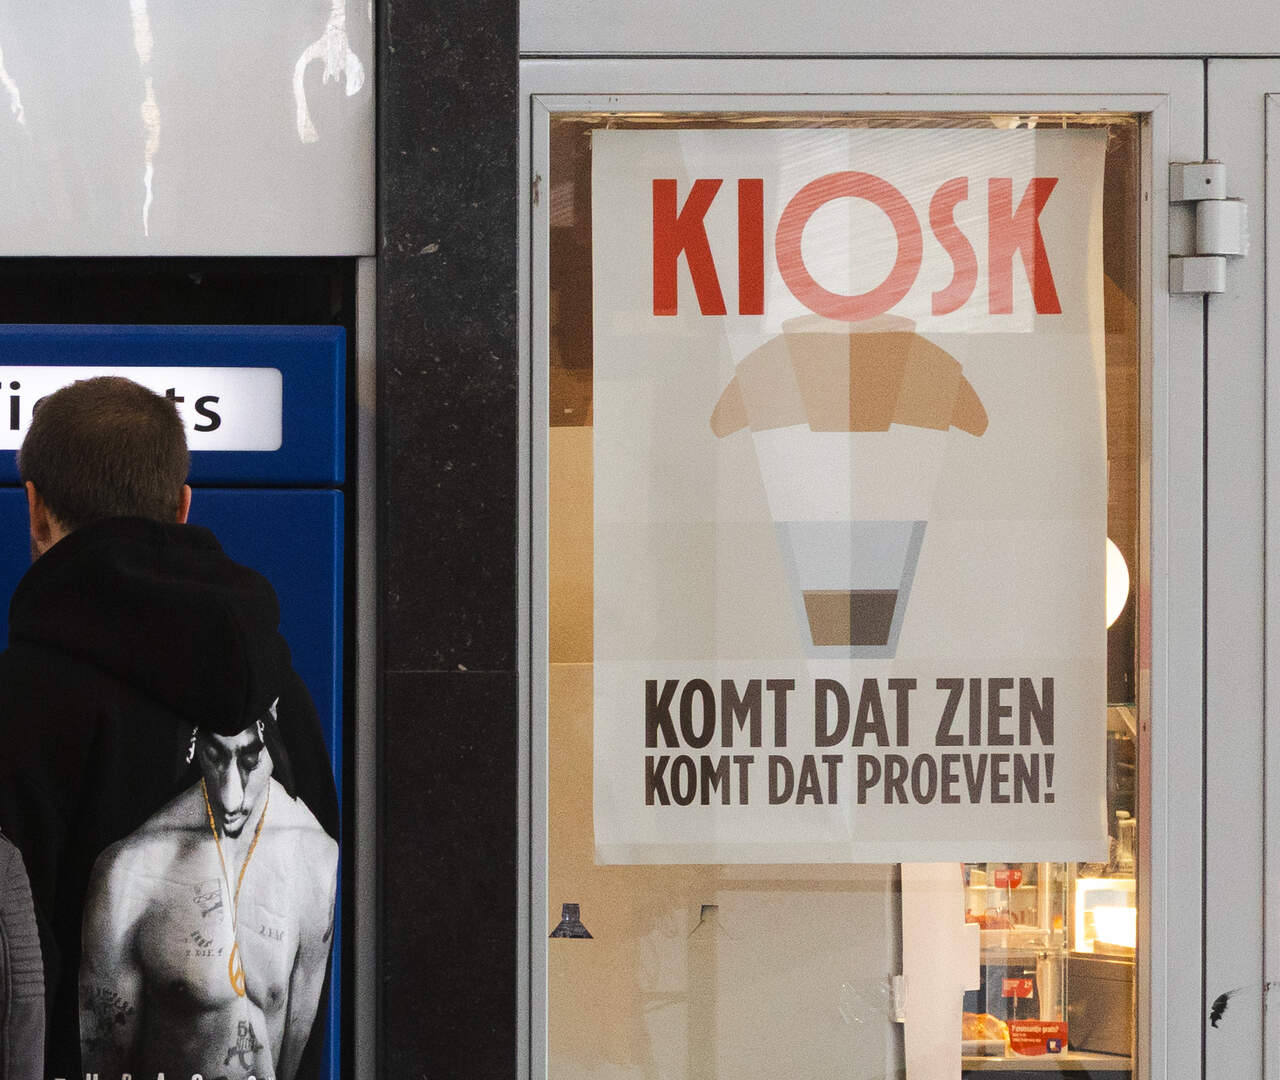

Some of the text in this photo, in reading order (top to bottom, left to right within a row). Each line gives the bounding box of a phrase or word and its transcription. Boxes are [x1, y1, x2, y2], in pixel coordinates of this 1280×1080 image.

[652, 170, 1063, 322] KIOSK
[645, 677, 1055, 748] KOMT DAT ZIEN
[645, 753, 1055, 806] KOMT DAT PROEVEN!
